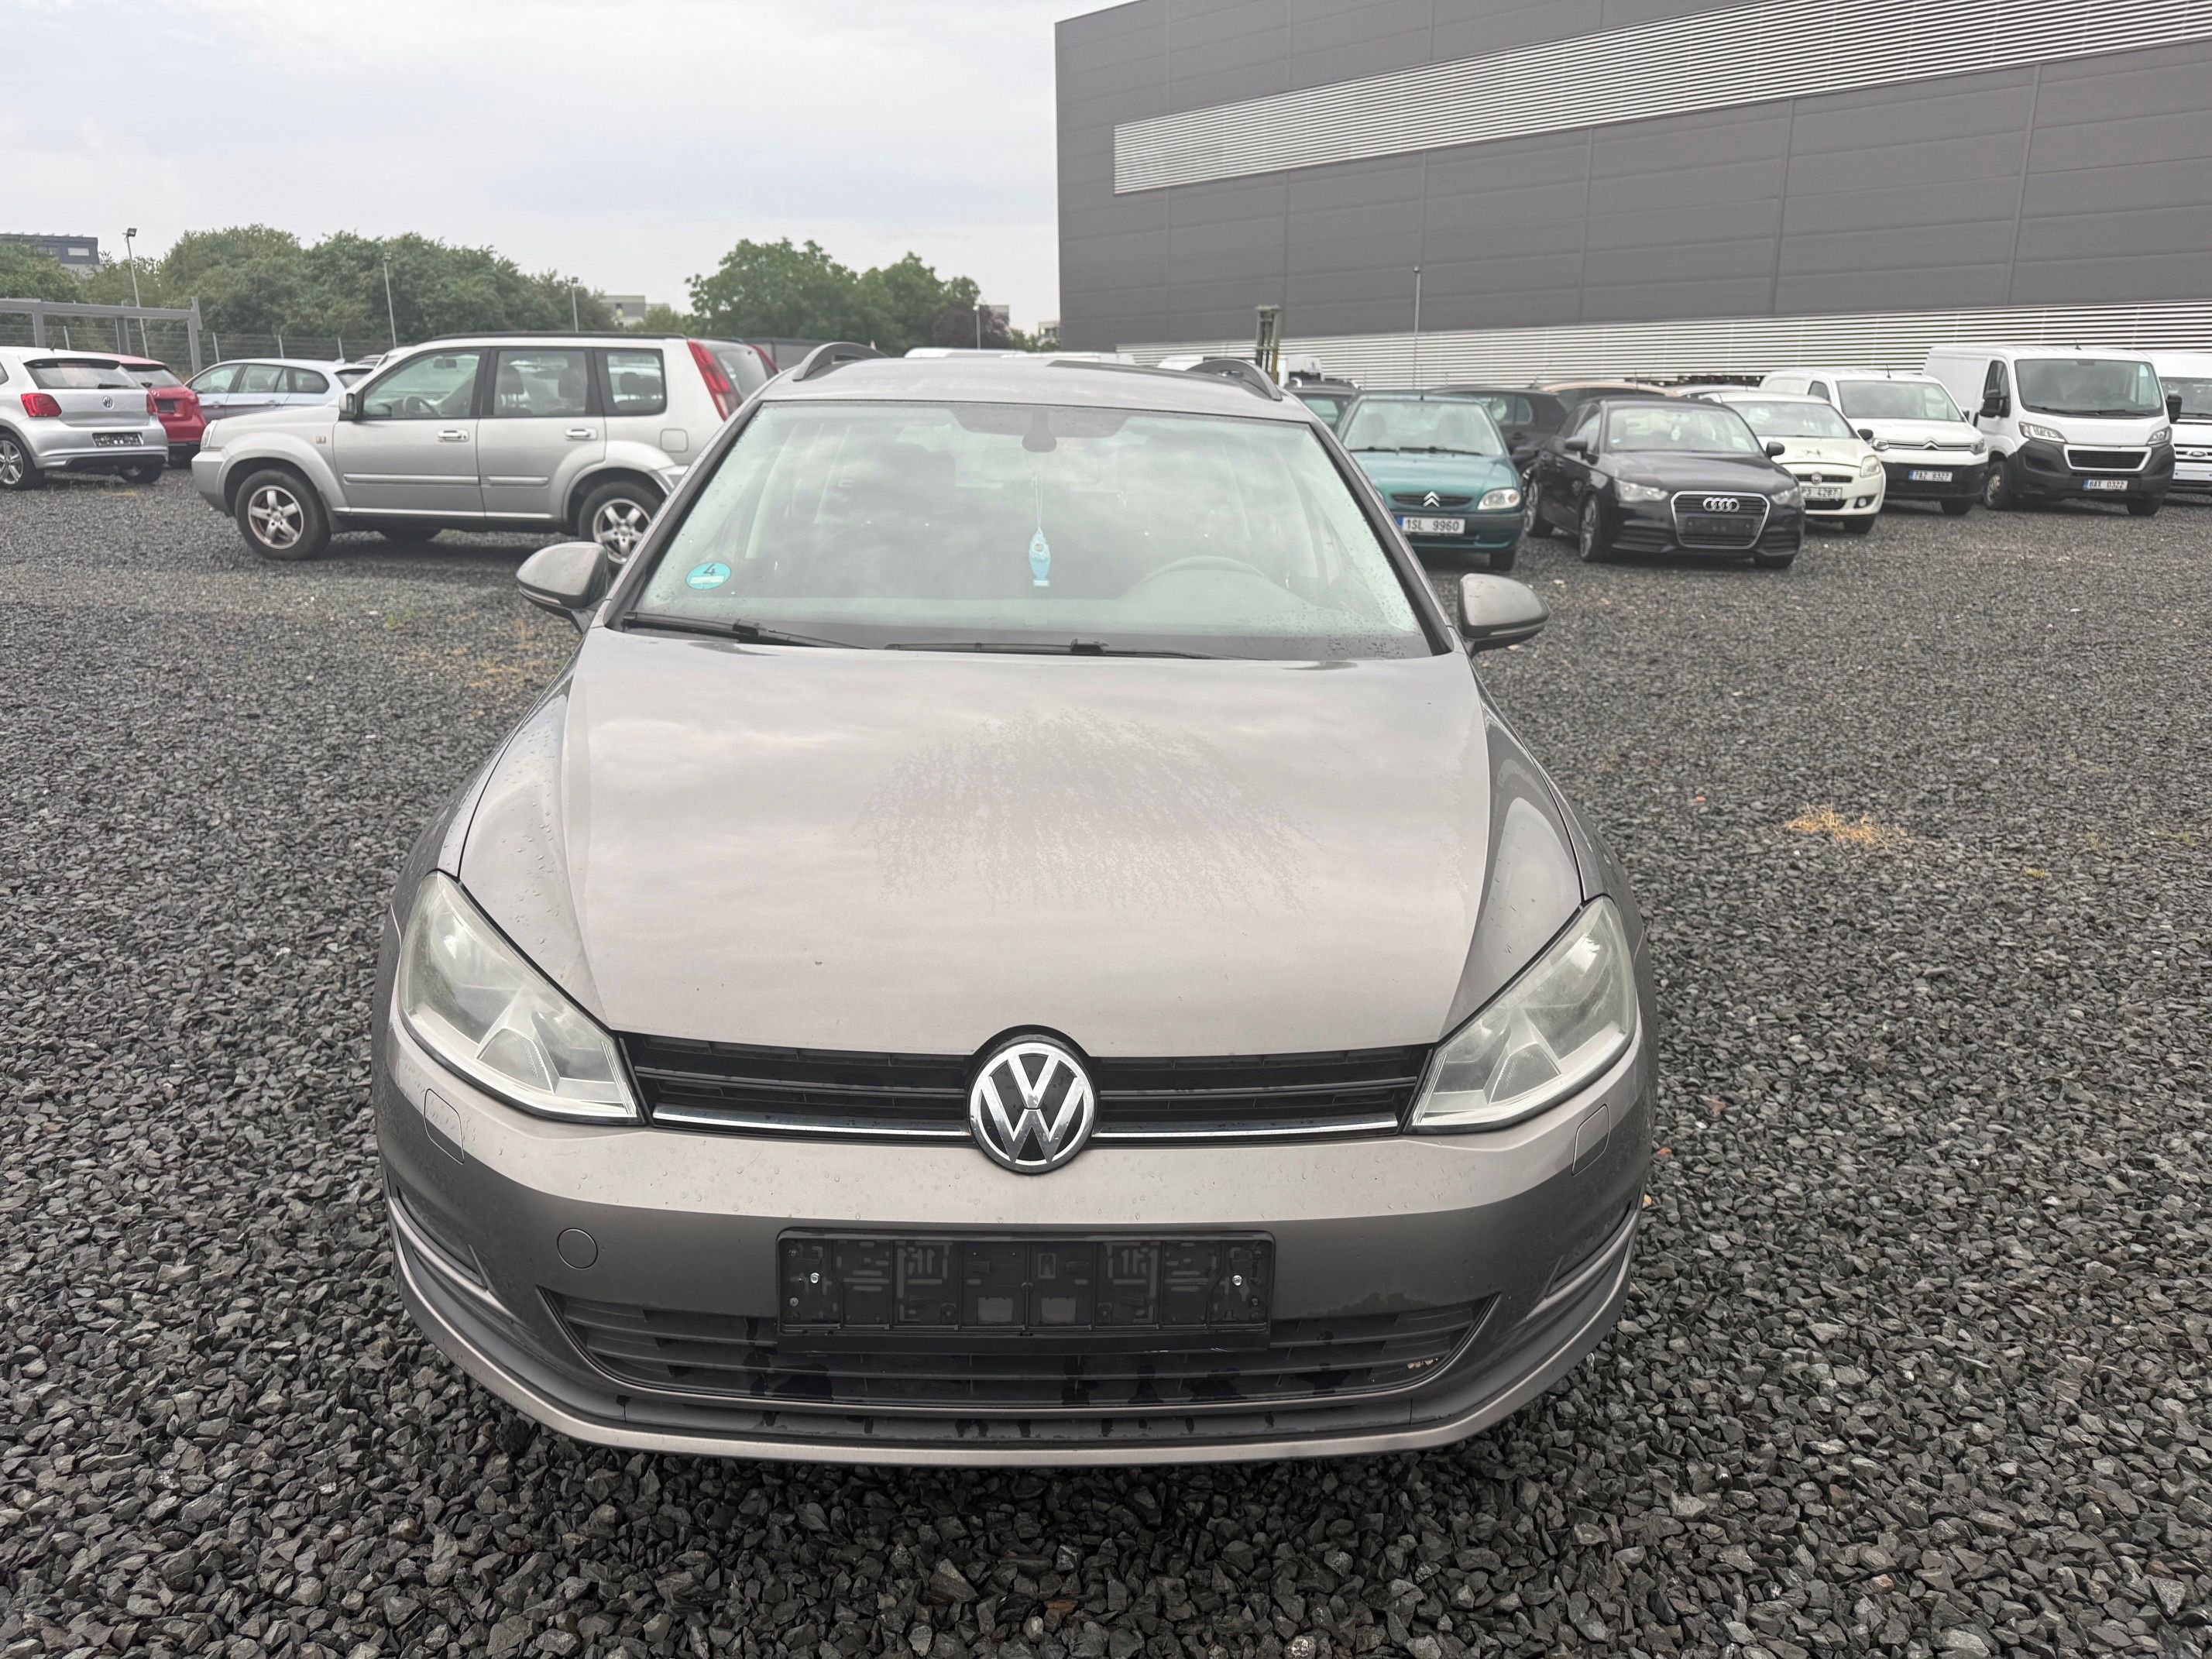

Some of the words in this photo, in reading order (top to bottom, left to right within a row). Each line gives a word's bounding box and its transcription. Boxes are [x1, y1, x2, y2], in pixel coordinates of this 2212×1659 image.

[1405, 519, 1424, 531] 1SL
[1432, 520, 1459, 531] 9960
[703, 563, 716, 575] 4
[974, 1046, 1091, 1167] VW
